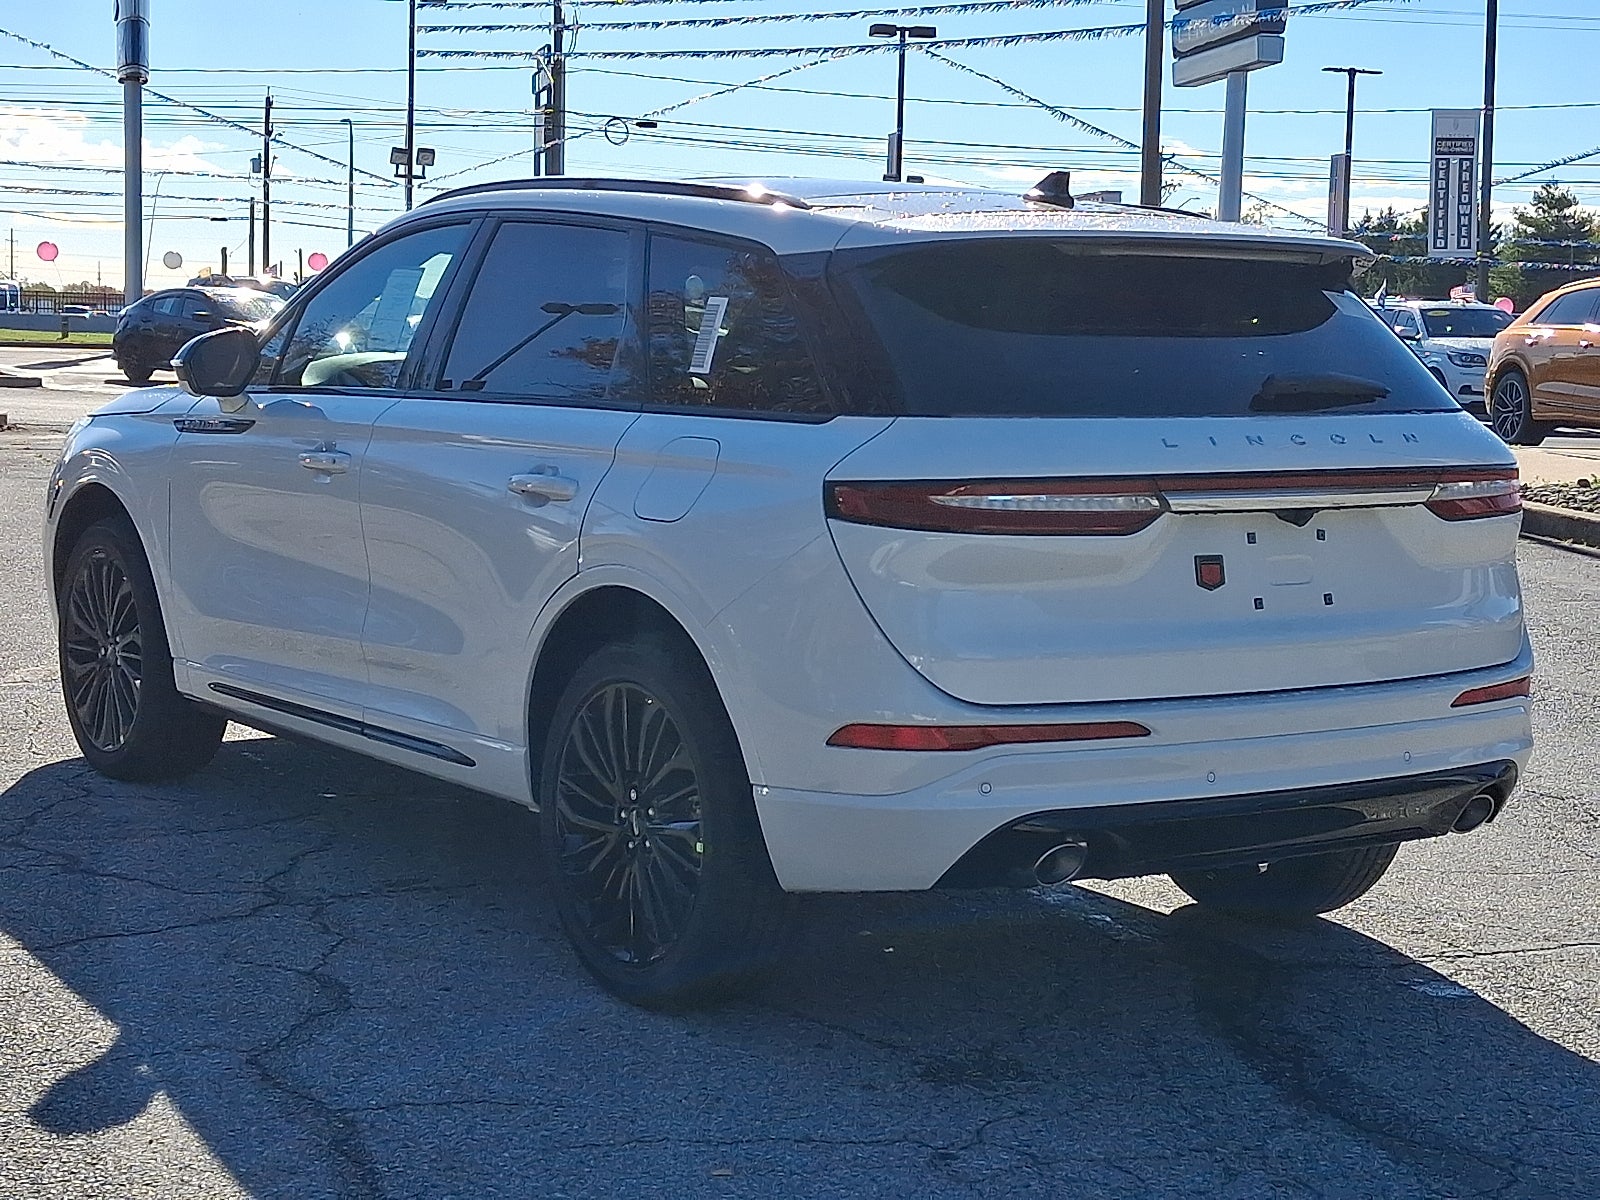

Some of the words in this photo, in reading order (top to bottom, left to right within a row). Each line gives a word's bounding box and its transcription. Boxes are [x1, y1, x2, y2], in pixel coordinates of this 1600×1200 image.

[1436, 160, 1447, 248] CERTIFIED
[1459, 160, 1471, 248] PREOWNED
[1161, 432, 1421, 449] LINCOLN
